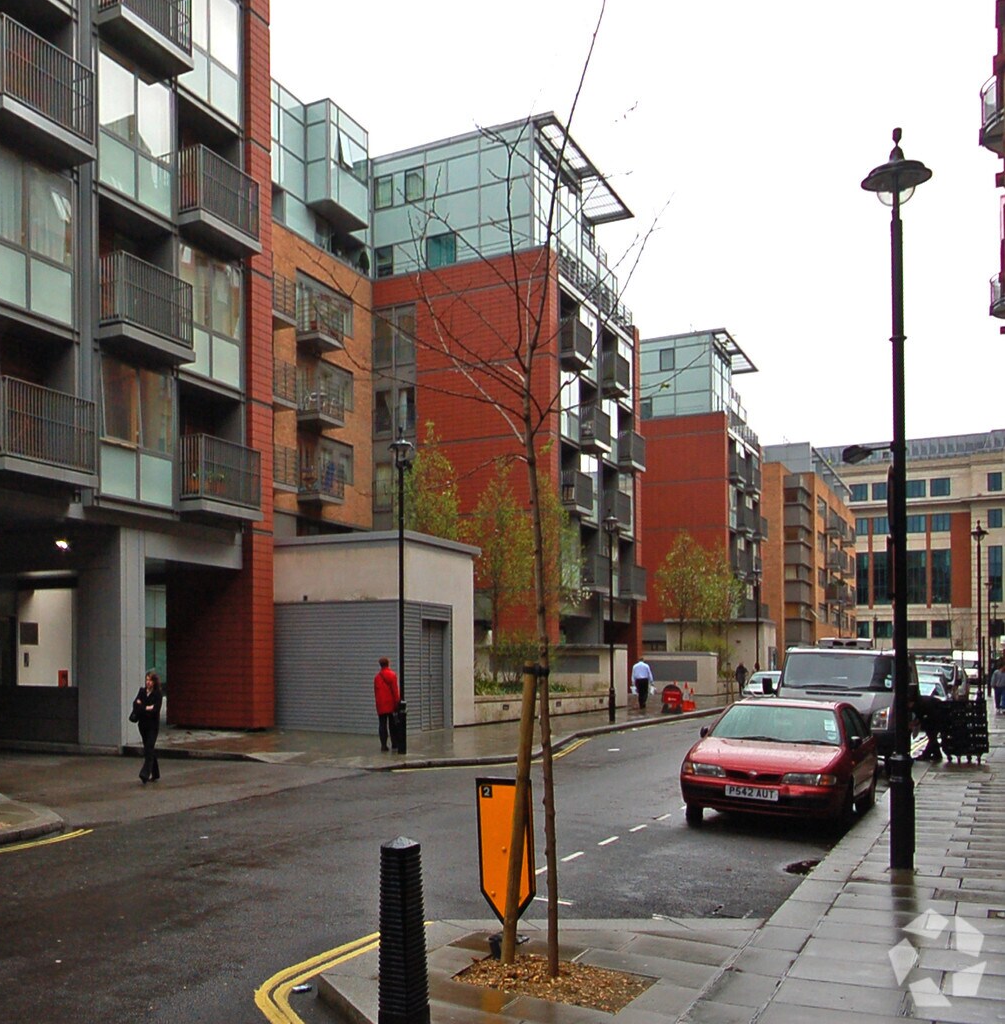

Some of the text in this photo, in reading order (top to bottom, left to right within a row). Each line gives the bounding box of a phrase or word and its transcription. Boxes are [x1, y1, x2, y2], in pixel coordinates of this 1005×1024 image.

[483, 786, 490, 796] 2
[728, 786, 775, 799] P542 AUT
